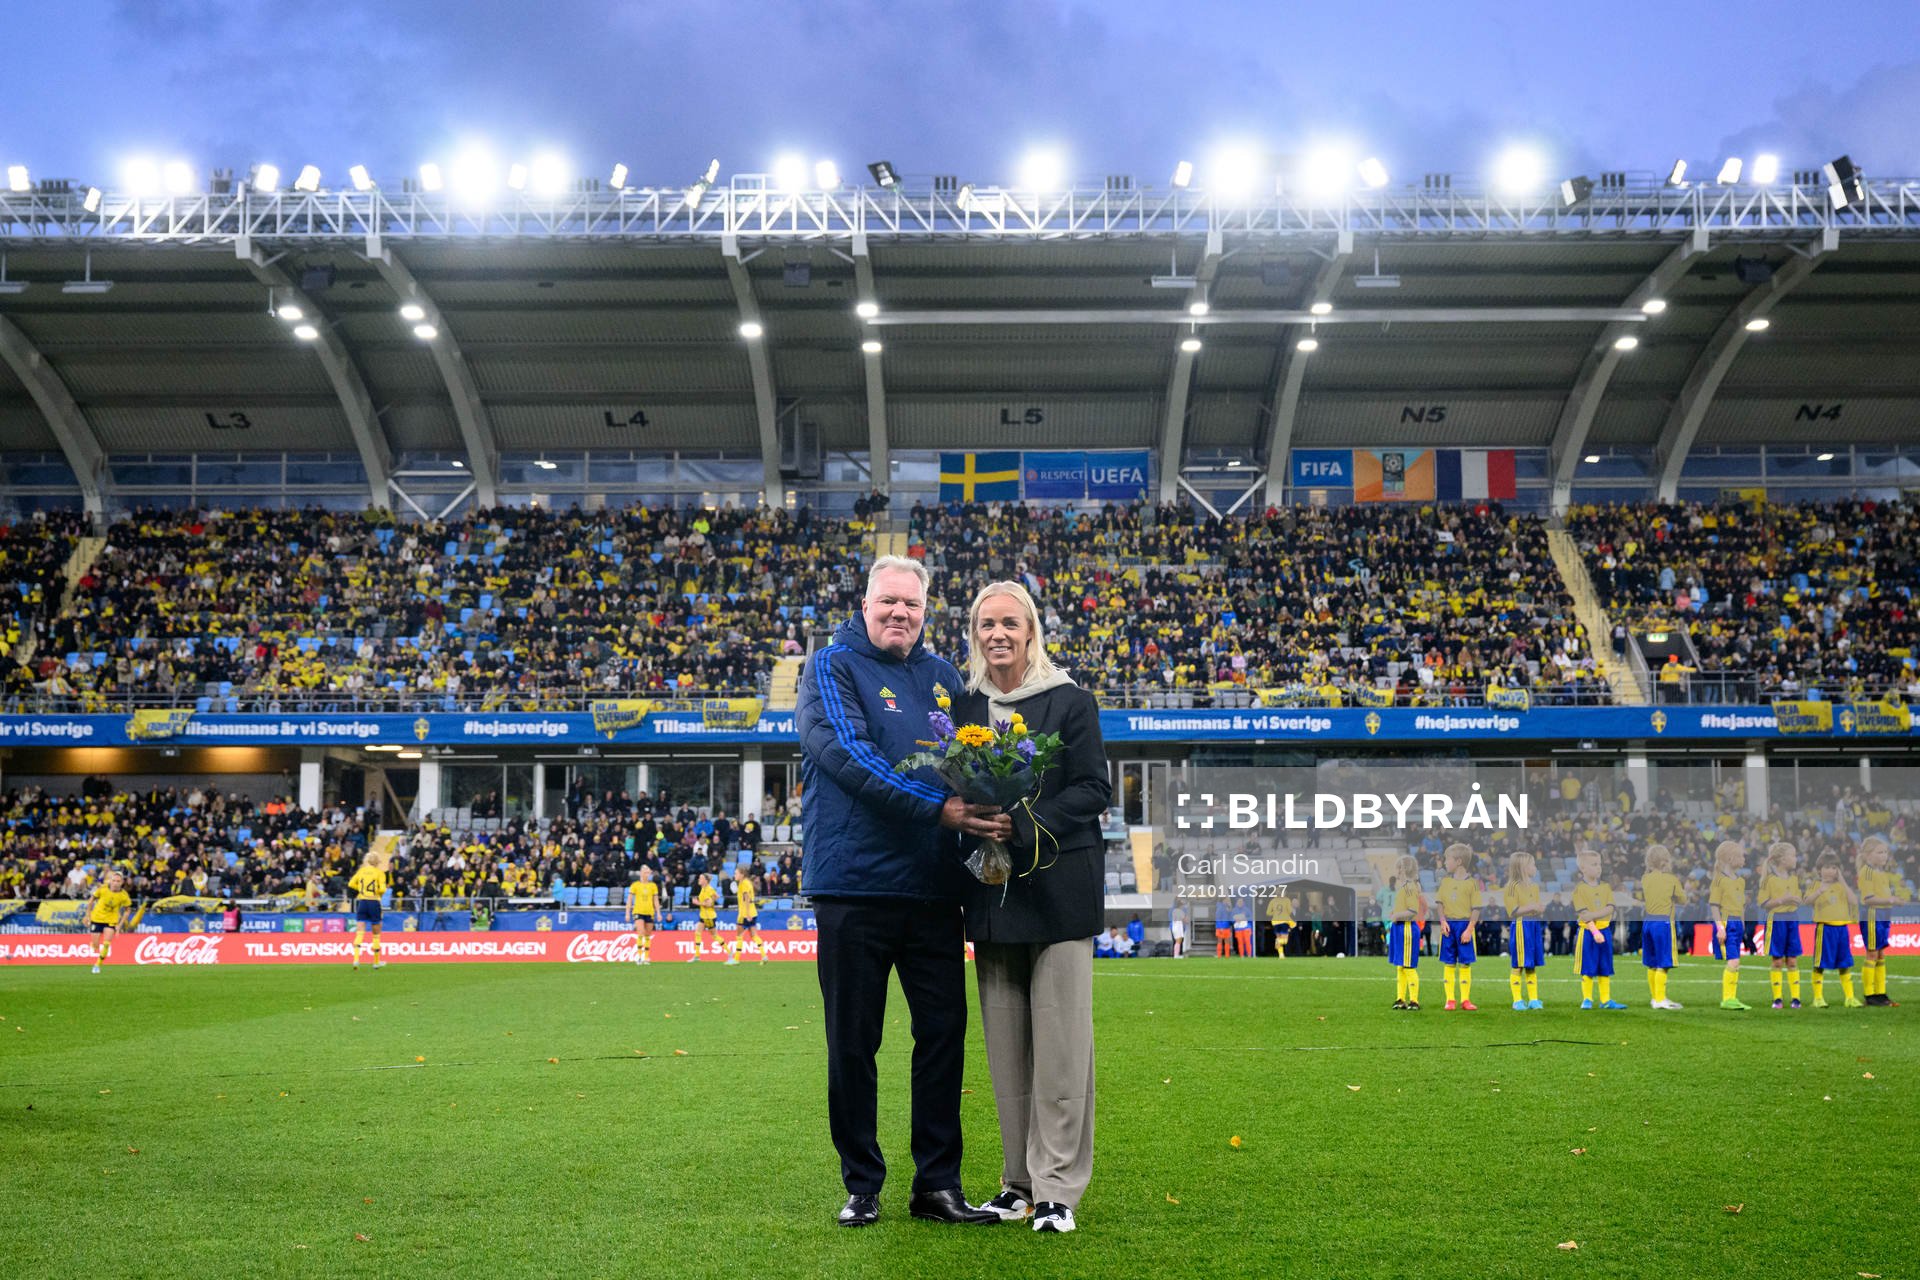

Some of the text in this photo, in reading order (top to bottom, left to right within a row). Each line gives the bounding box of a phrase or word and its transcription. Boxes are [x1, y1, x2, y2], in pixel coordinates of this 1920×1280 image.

[205, 412, 251, 429] L3
[604, 410, 649, 427] L4
[1001, 408, 1043, 425] L5
[1400, 406, 1446, 424] N5
[1794, 404, 1842, 421] N4
[1040, 469, 1084, 480] RESPECT
[1091, 467, 1143, 484] UEFA
[1300, 461, 1343, 476] FIFA
[15, 721, 29, 735] vi
[31, 721, 93, 738] Sverige
[185, 721, 278, 736] illsammans
[280, 721, 298, 736] är
[301, 721, 315, 735] vi
[317, 721, 379, 738] Sverige
[464, 720, 569, 737] #hejasverige
[758, 719, 775, 733] är
[777, 719, 793, 733] vi
[1128, 716, 1332, 732] Tillsammans är vi Sverige
[1415, 715, 1520, 732] #hejasverige
[361, 878, 376, 896] 14
[135, 935, 224, 964] Coca-Cola
[245, 943, 278, 956] TILL
[280, 942, 354, 956] SVENSKA
